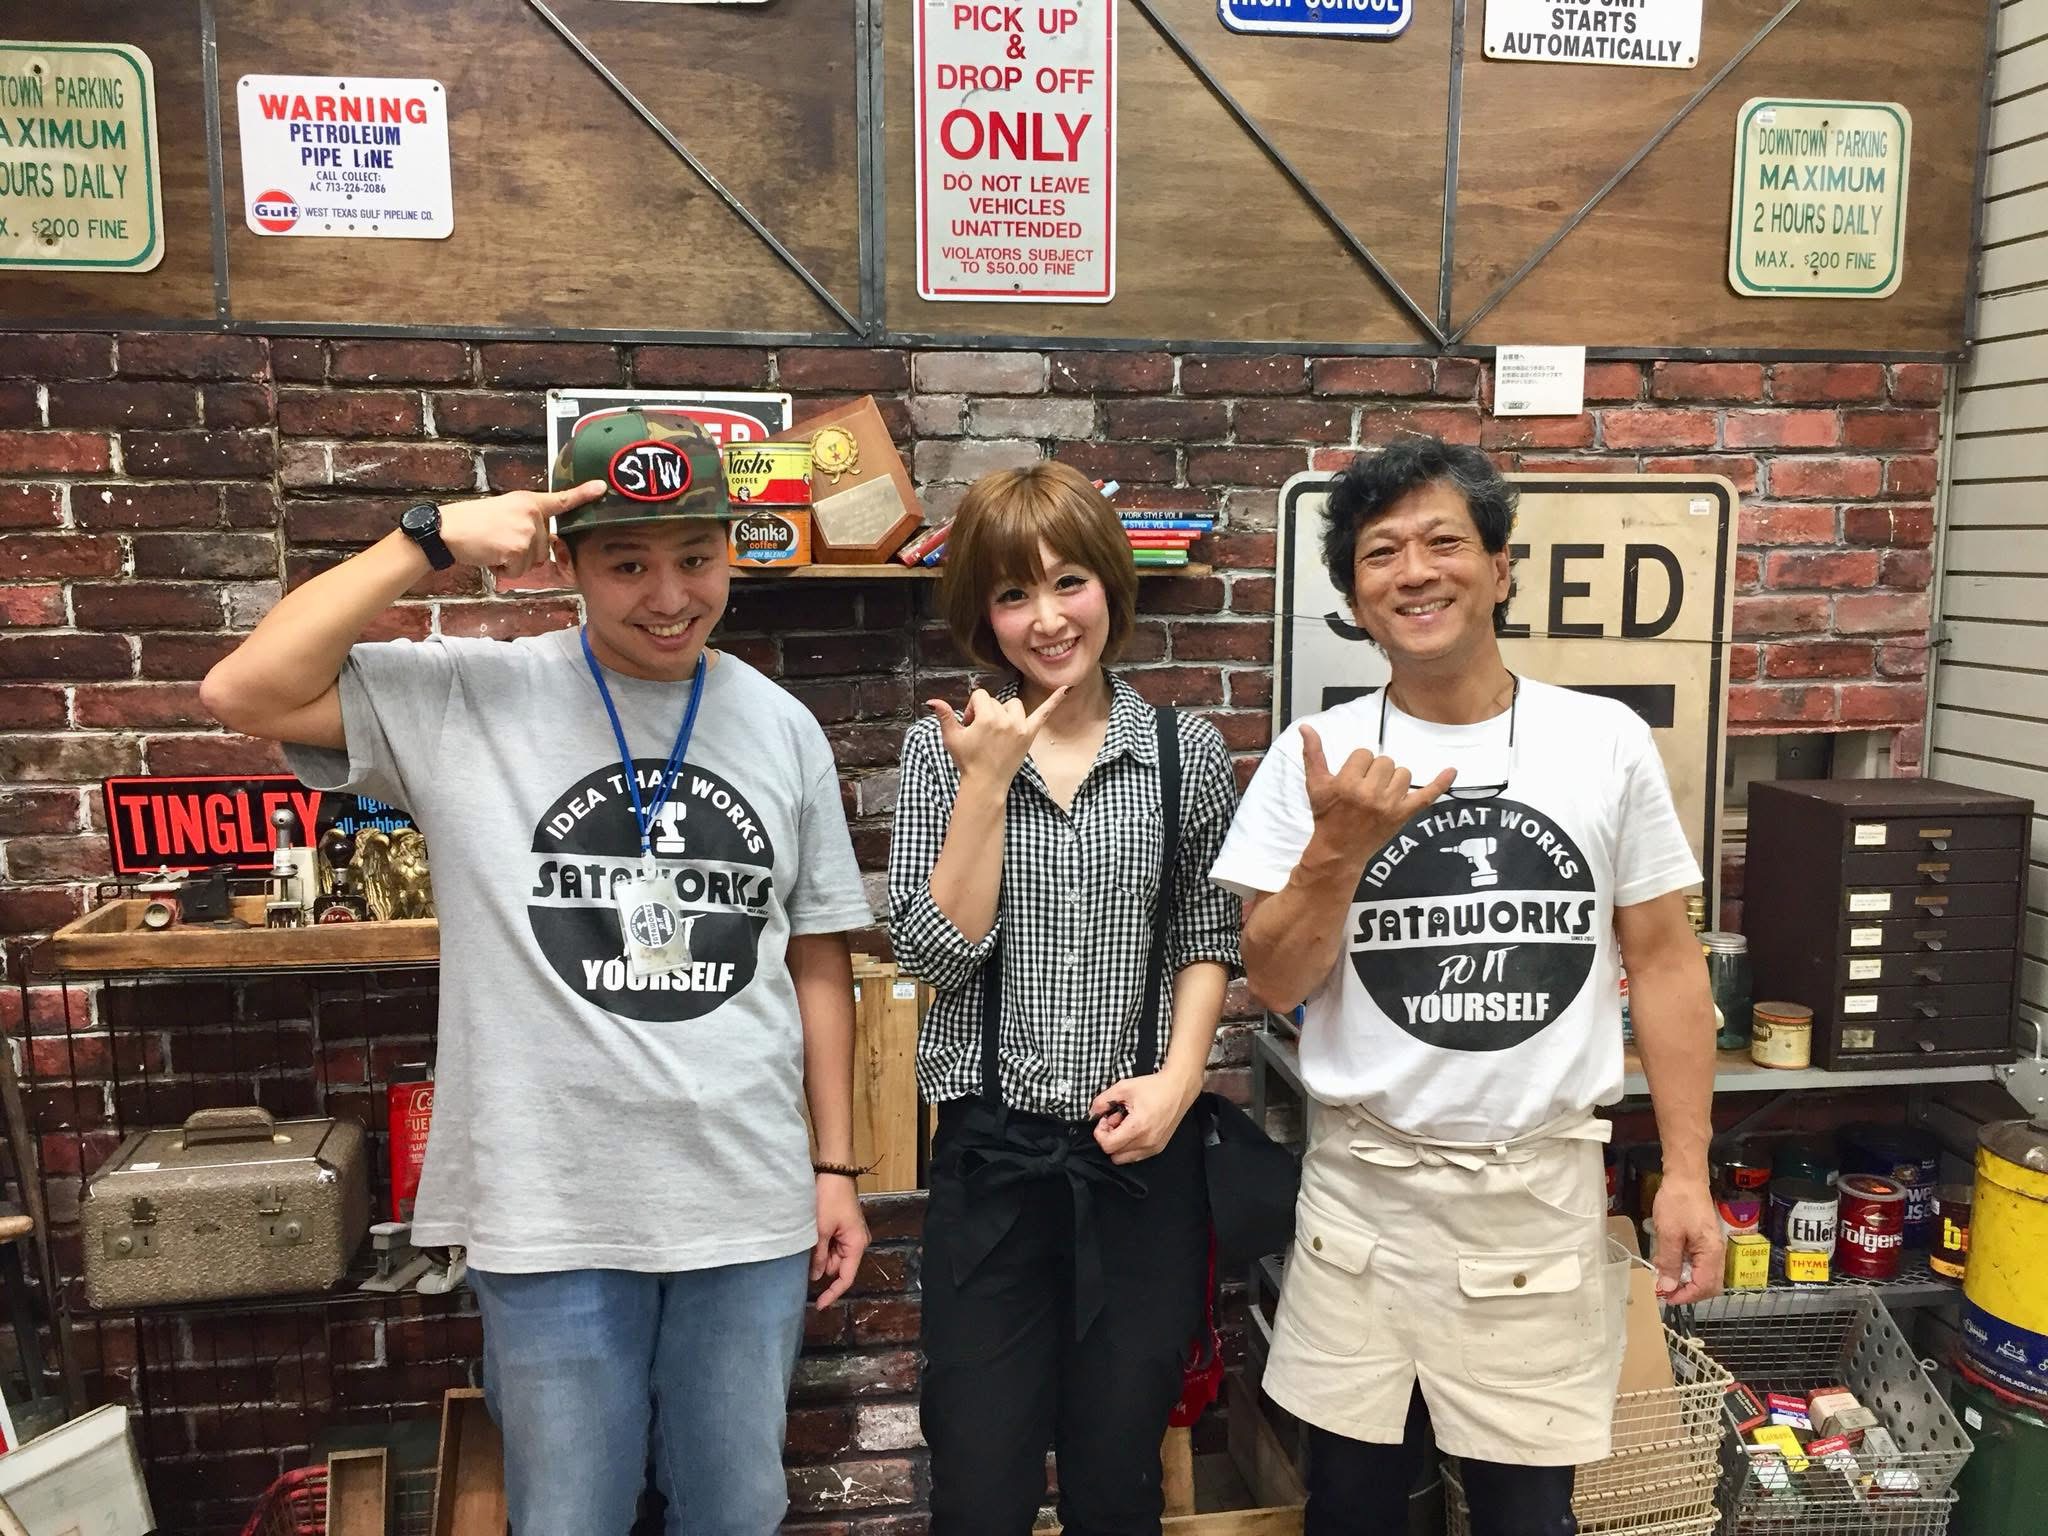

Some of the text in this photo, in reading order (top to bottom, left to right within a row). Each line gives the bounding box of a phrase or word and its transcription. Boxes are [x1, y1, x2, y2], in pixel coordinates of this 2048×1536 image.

[954, 5, 1078, 35] PICK UP
[1551, 8, 1637, 34] STARTS
[1006, 33, 1026, 60] &
[1502, 32, 1682, 62] AUTOMATICALLY
[937, 64, 1095, 94] DROP OFF
[55, 76, 124, 109] PARKING
[258, 94, 428, 124] WARNING
[289, 123, 401, 146] PETROLEUM
[940, 108, 1093, 162] ONLY
[1758, 127, 1888, 158] DOWNTOWN PARKING
[301, 147, 394, 169] PIPE LINE
[63, 163, 128, 199] DAILY
[310, 182, 386, 194] AC 713-226-2086
[316, 171, 381, 182] CALL COLLECT:
[943, 174, 1090, 194] DO NOT LEAVE
[1759, 164, 1886, 193] MAXIMUM
[254, 204, 299, 218] Gulf
[305, 207, 434, 221] WEST TEXAS GULF PIPELINE CO.
[969, 197, 1065, 216] VEHICLES
[1753, 202, 1883, 236] 2 HOURS DAILY
[32, 217, 80, 239] $200
[88, 219, 129, 239] FINE
[951, 220, 1082, 239] UNATTENDED
[941, 247, 1093, 263] VIOLATORS SUBJECT
[1755, 250, 1877, 270] MAX. $200 FINE
[961, 261, 1076, 276] TO $50.00 FINE
[731, 477, 758, 485] COFFEE
[1124, 511, 1142, 519] YORK
[1143, 511, 1164, 519] STYLE
[1130, 520, 1149, 528] STYLE
[740, 523, 788, 542] Sanka
[746, 550, 788, 559] RICH BLEND
[119, 791, 322, 855] TINGLEY
[545, 787, 608, 840] IDEA
[691, 775, 765, 855] WORKS
[1364, 807, 1580, 888] IDEA THAT WORKS
[1353, 900, 1596, 944] SATAWORKS
[582, 959, 735, 993] YOURSELF
[1482, 945, 1520, 983] IT
[1402, 992, 1550, 1025] YOURSELF
[1840, 1220, 1904, 1253] Folgers
[1791, 1260, 1828, 1268] THYME
